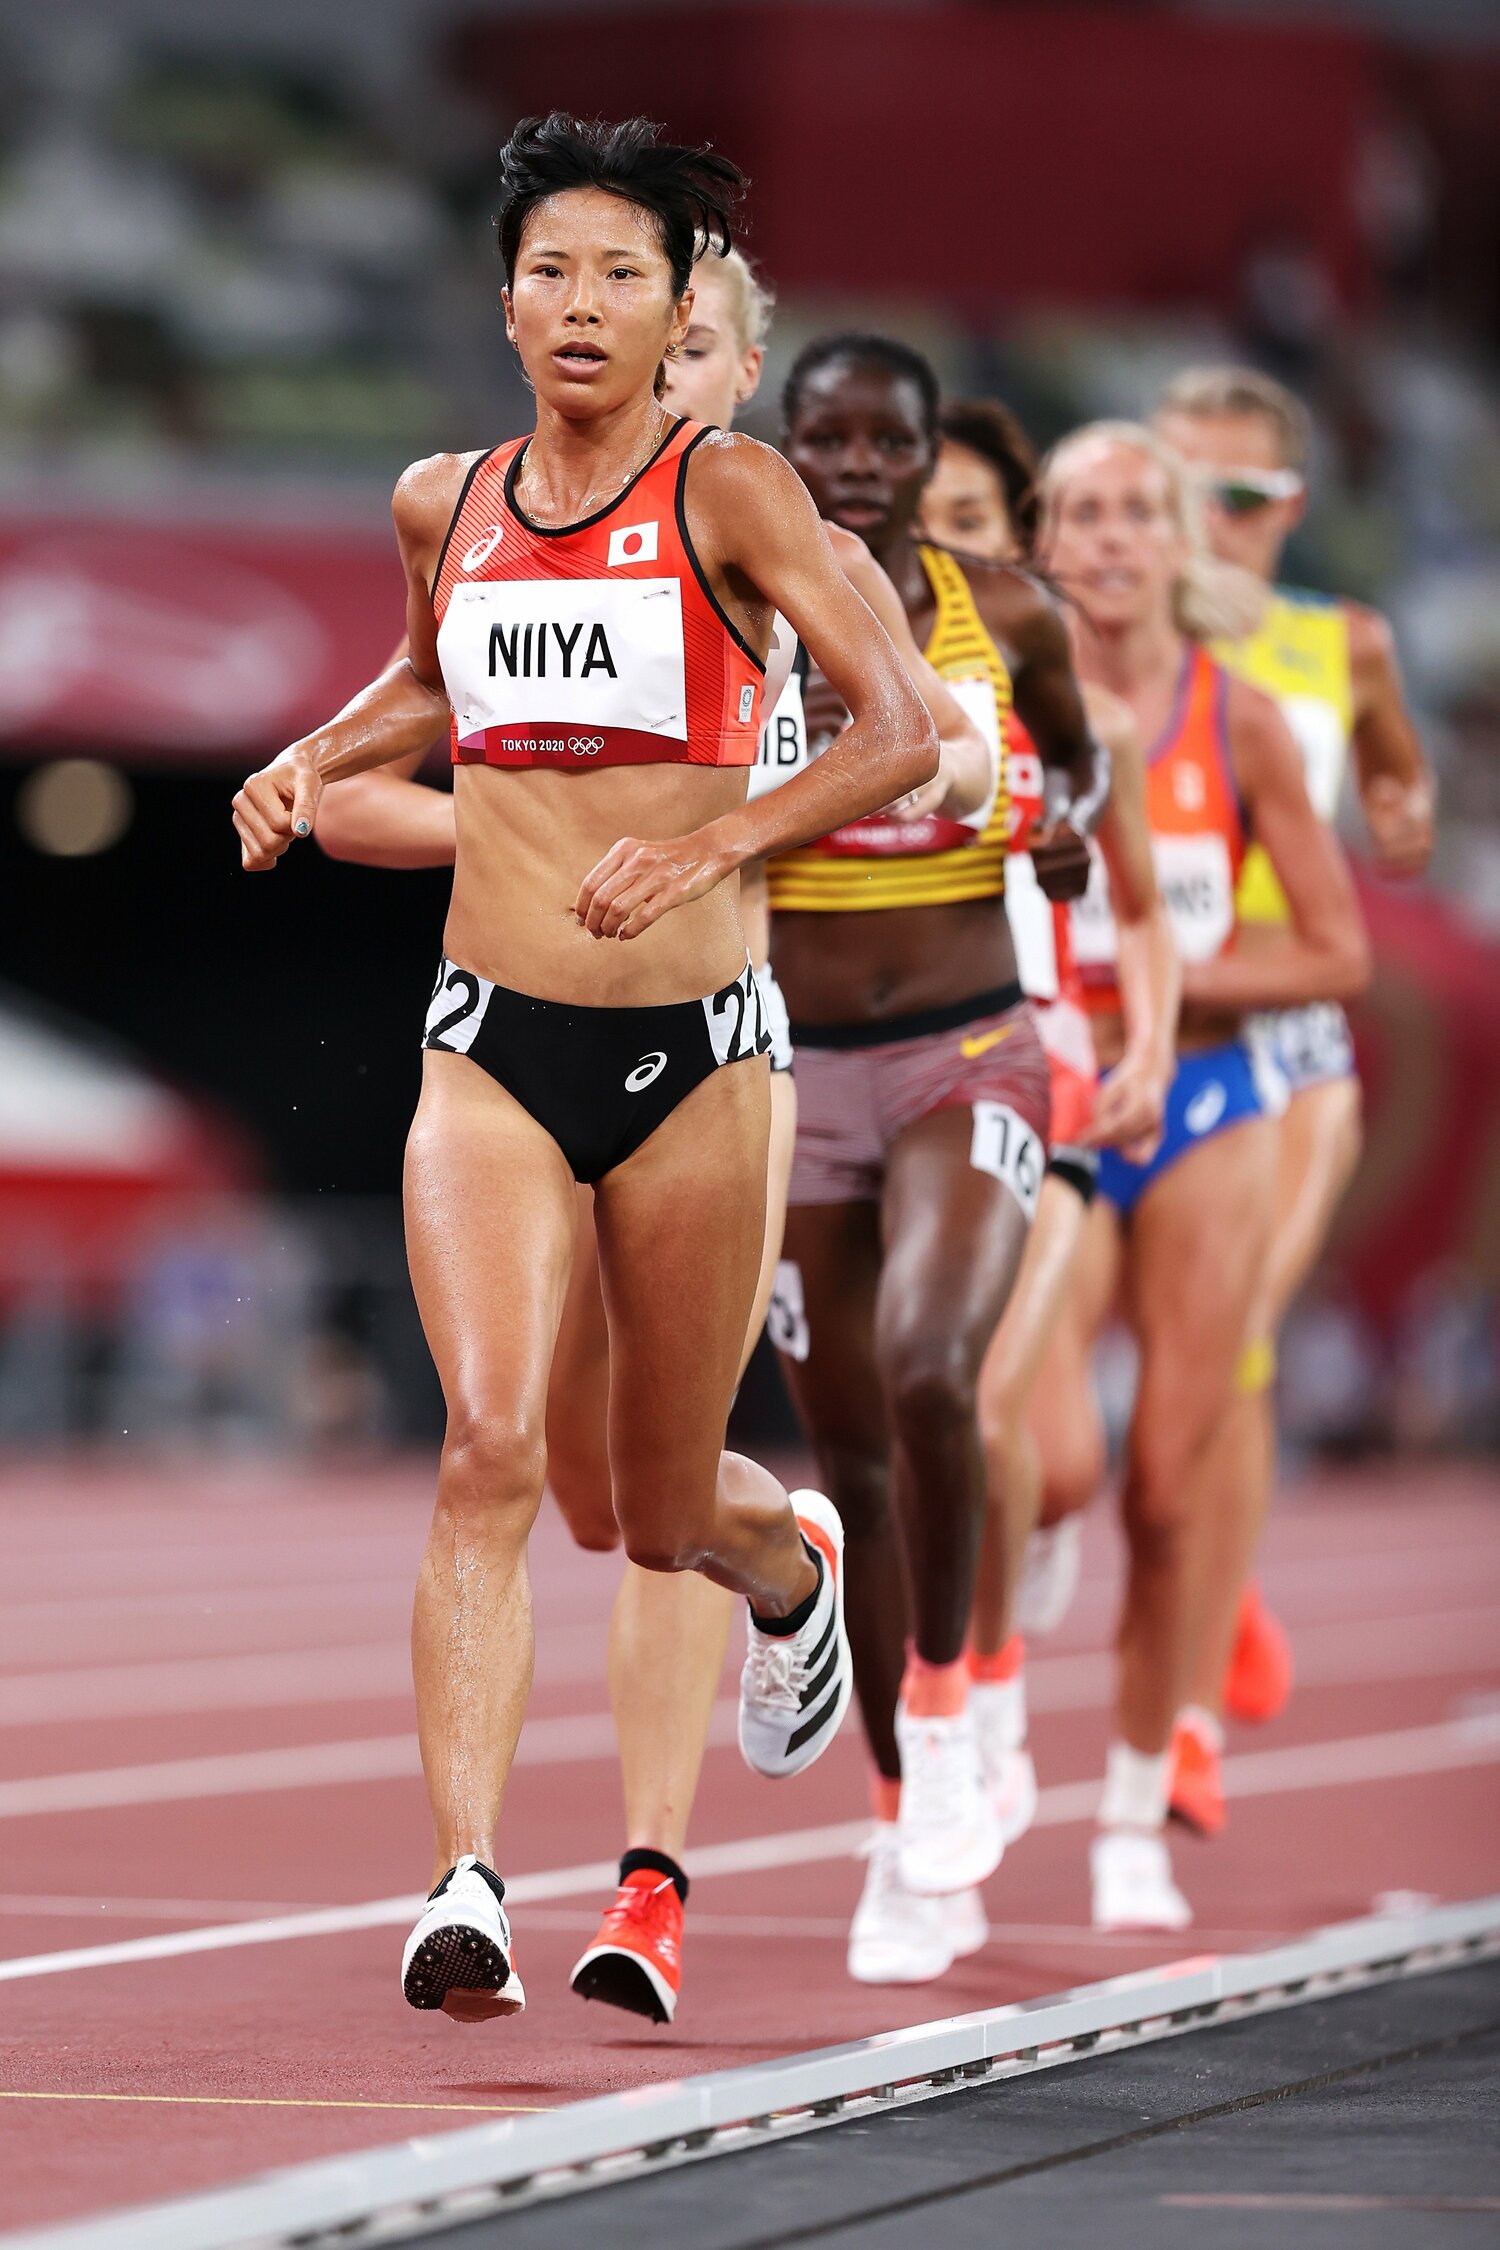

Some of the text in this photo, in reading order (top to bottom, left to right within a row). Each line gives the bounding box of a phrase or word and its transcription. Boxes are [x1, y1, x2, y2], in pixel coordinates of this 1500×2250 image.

[488, 623, 618, 678] NIIYA
[501, 739, 565, 752] TOKYO 2020
